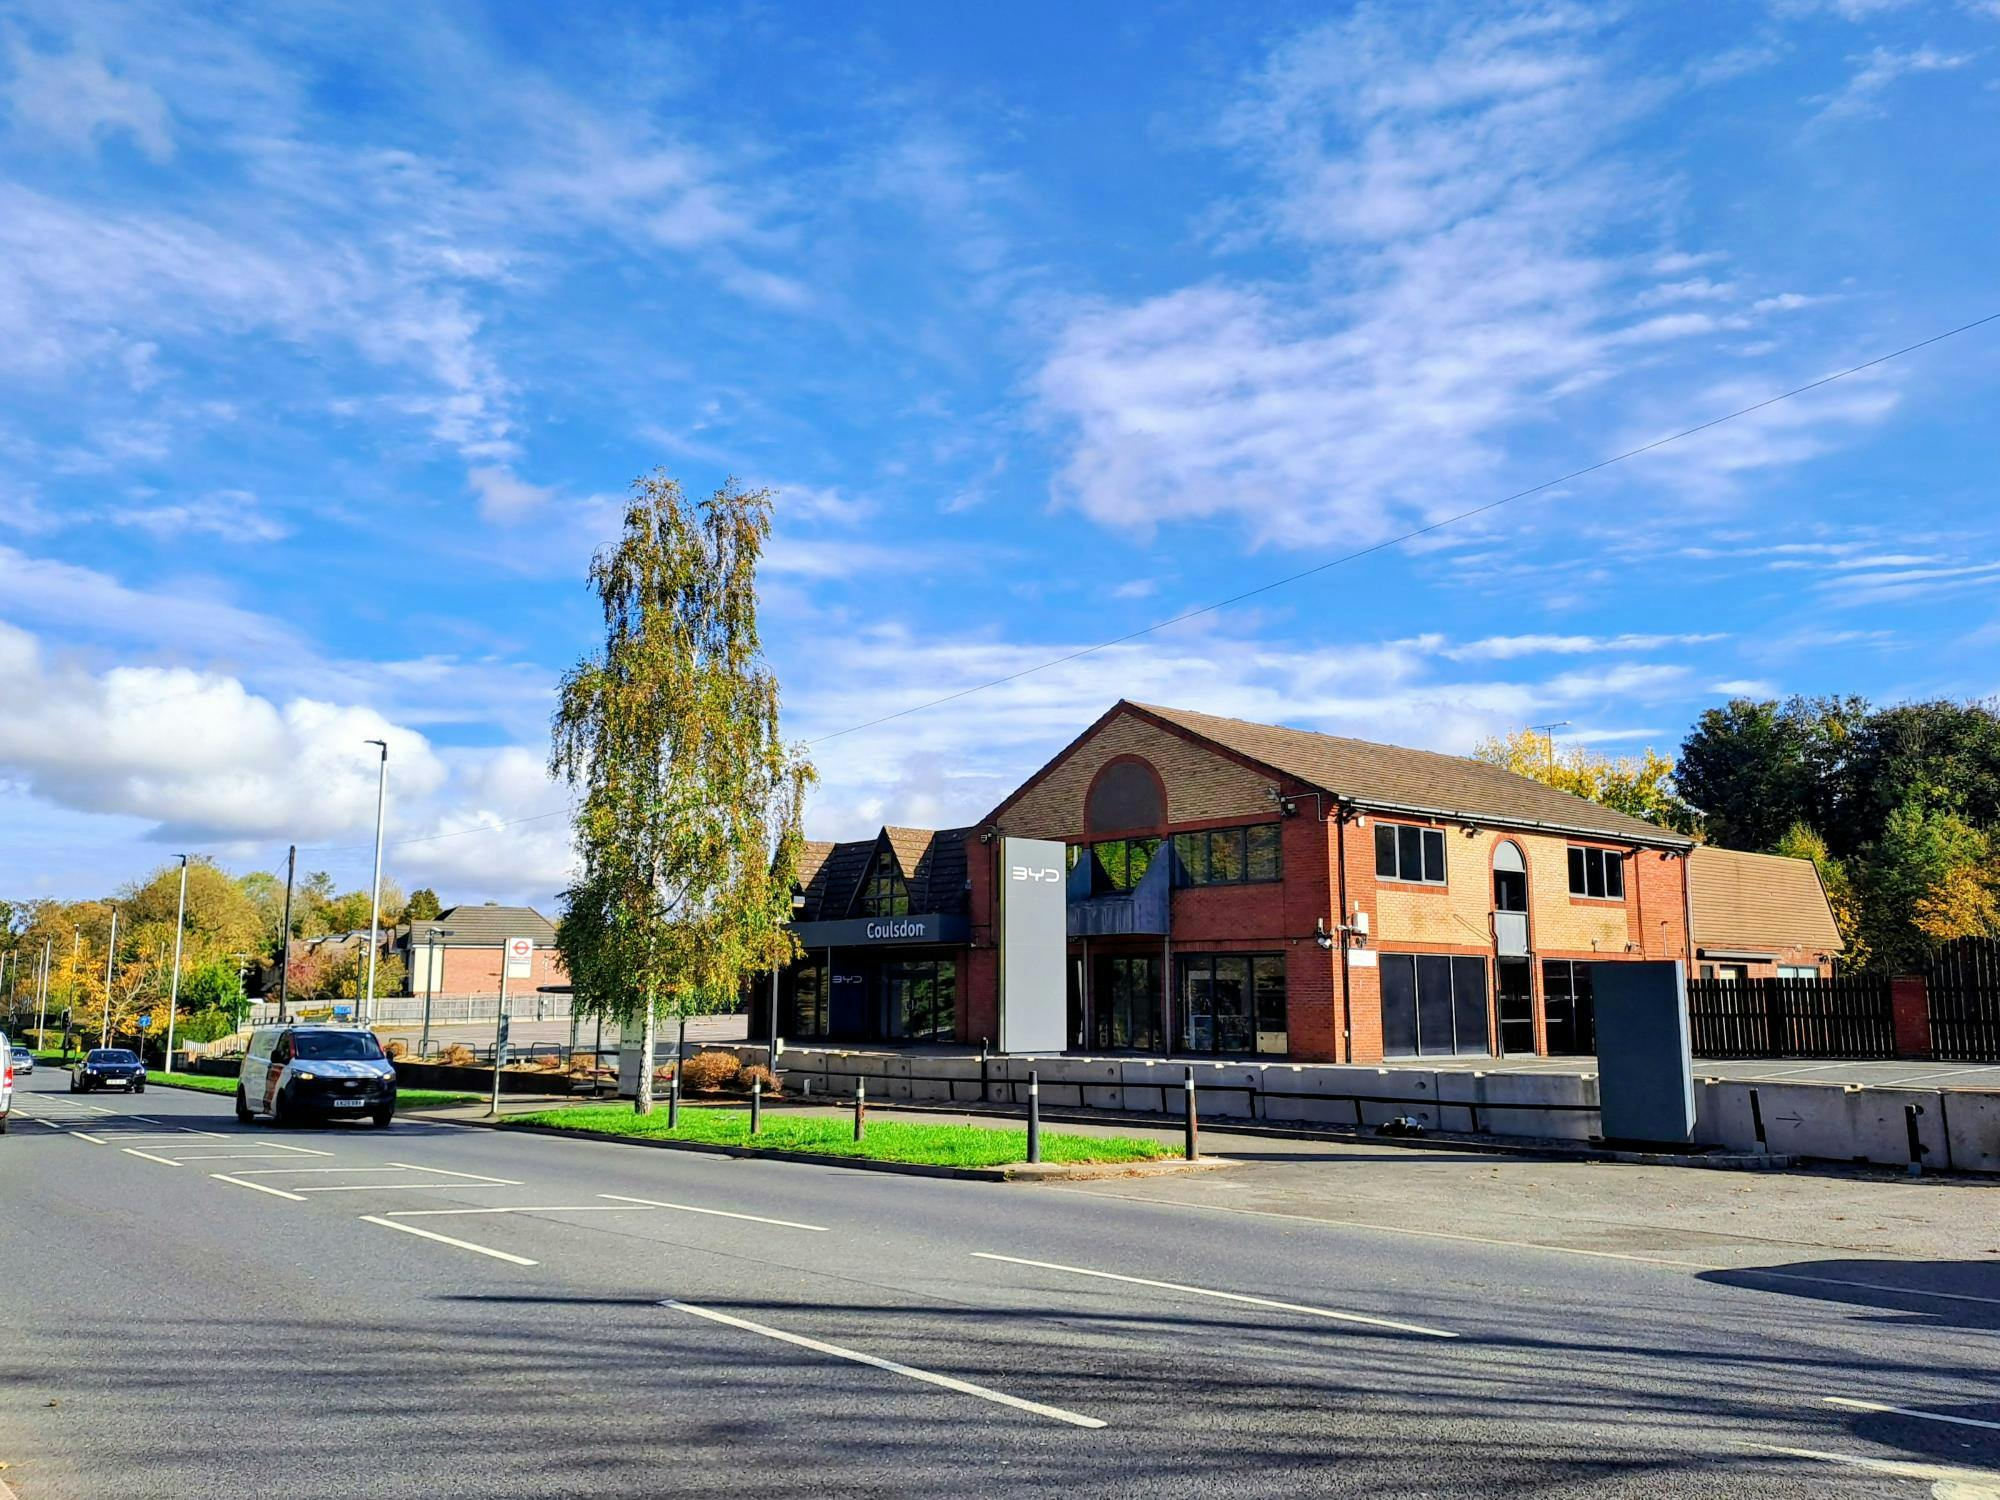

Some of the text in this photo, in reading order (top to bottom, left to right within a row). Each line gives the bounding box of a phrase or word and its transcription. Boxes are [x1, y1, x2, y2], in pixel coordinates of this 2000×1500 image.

[1012, 866, 1060, 883] BYD
[866, 919, 926, 939] Coulsdon
[831, 975, 863, 984] BYD
